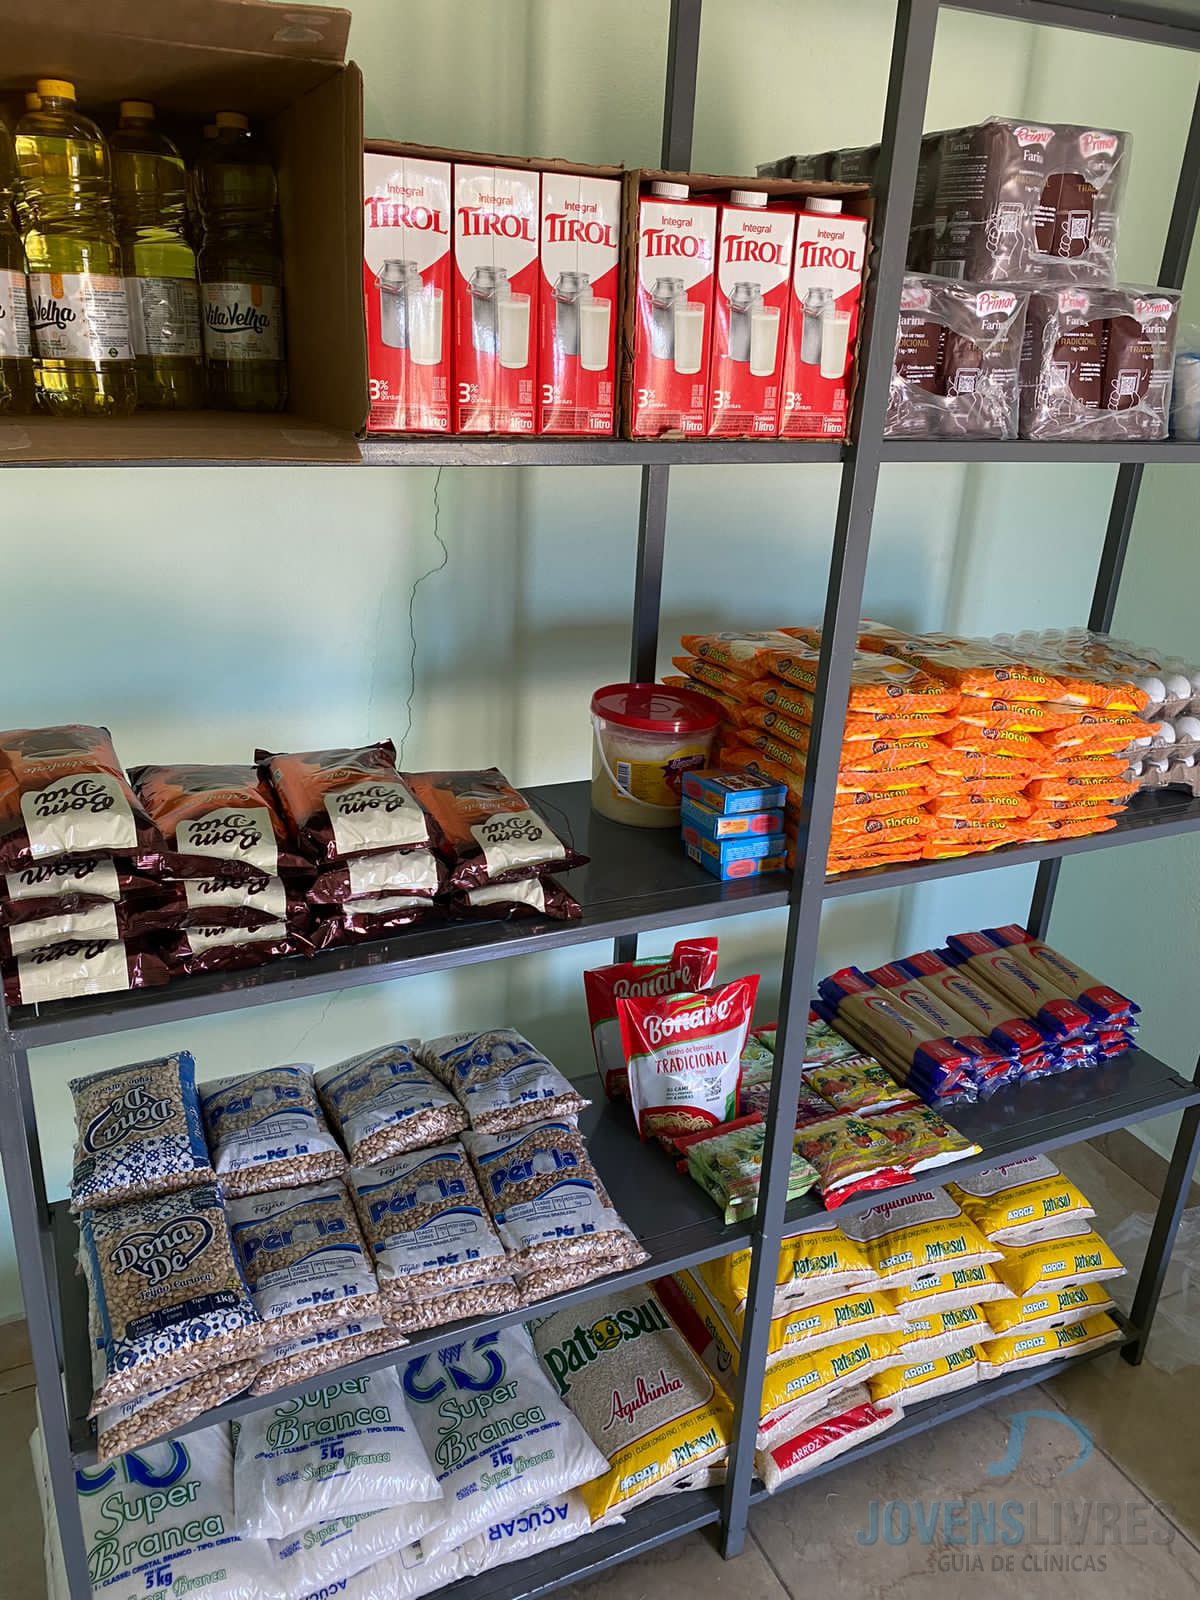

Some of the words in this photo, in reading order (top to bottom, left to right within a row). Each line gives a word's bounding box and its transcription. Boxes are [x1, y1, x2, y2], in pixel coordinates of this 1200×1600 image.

[387, 183, 424, 197] Integral
[479, 193, 513, 206] Integral
[364, 197, 448, 235] TIROL
[565, 200, 597, 213] Integral
[458, 207, 536, 242] TIROL
[545, 213, 617, 248] TIROL
[662, 216, 693, 228] Integral
[743, 223, 772, 235] Integral
[642, 229, 712, 261] TIROL
[817, 230, 845, 241] Integral
[723, 234, 788, 266] TIROL
[800, 240, 860, 272] TIROL
[978, 292, 1017, 312] Primor
[228, 303, 270, 332] Velha
[777, 696, 804, 716] Flocão
[775, 720, 802, 740] Flocão
[767, 743, 793, 764] Flocão
[35, 780, 106, 805] Dia
[36, 793, 115, 817] Bom
[339, 797, 405, 814] Bom
[189, 814, 256, 832] Dia
[482, 818, 532, 834] Dia
[885, 816, 921, 828] Flocão
[189, 828, 262, 848] Bom
[488, 827, 543, 842] Bom
[614, 964, 692, 996] Bonare
[643, 999, 734, 1044] Bonare
[656, 1051, 728, 1074] TRADICIONAL
[520, 1088, 554, 1100] Pérla
[267, 1144, 308, 1160] Pérla
[1008, 1205, 1034, 1220] ARROZ
[555, 1222, 594, 1237] Pérla
[110, 1222, 192, 1274] Dona
[437, 1248, 479, 1266] Pérla
[879, 1252, 912, 1270] ARROZ
[926, 1236, 966, 1262] patosul
[143, 1250, 190, 1286] Dê
[793, 1251, 838, 1278] patosul
[1042, 1261, 1066, 1274] ARROZ
[910, 1278, 942, 1294] ARROZ
[952, 1264, 986, 1288] patosul
[138, 1284, 172, 1300] Feijão
[214, 1294, 236, 1304] 1kg
[312, 1284, 358, 1304] Pérla
[785, 1316, 820, 1336] ARROZ
[834, 1299, 874, 1325] patosul
[1022, 1301, 1048, 1315] ARROZ
[316, 1324, 362, 1344] Pérla
[1014, 1336, 1046, 1352] ARROZ
[544, 1298, 670, 1397] patosul
[786, 1371, 820, 1394] ARROZ
[832, 1343, 871, 1376] patosul
[904, 1361, 936, 1380] ARROZ
[275, 1374, 370, 1418] Super
[603, 1370, 684, 1431] Agulhinha
[438, 1380, 518, 1434] Super
[266, 1406, 391, 1450] Branca
[435, 1405, 546, 1470] Branca
[321, 1449, 328, 1460] 5
[330, 1442, 344, 1460] kg
[492, 1455, 500, 1468] 5
[500, 1450, 513, 1465] kg
[792, 1438, 822, 1462] ARROZ
[95, 1480, 200, 1539] Super
[489, 1504, 570, 1542] AÇÚCAR
[88, 1515, 224, 1585] Branca
[146, 1576, 154, 1589] 5
[156, 1569, 174, 1587] kg
[172, 1568, 227, 1597] Branca
